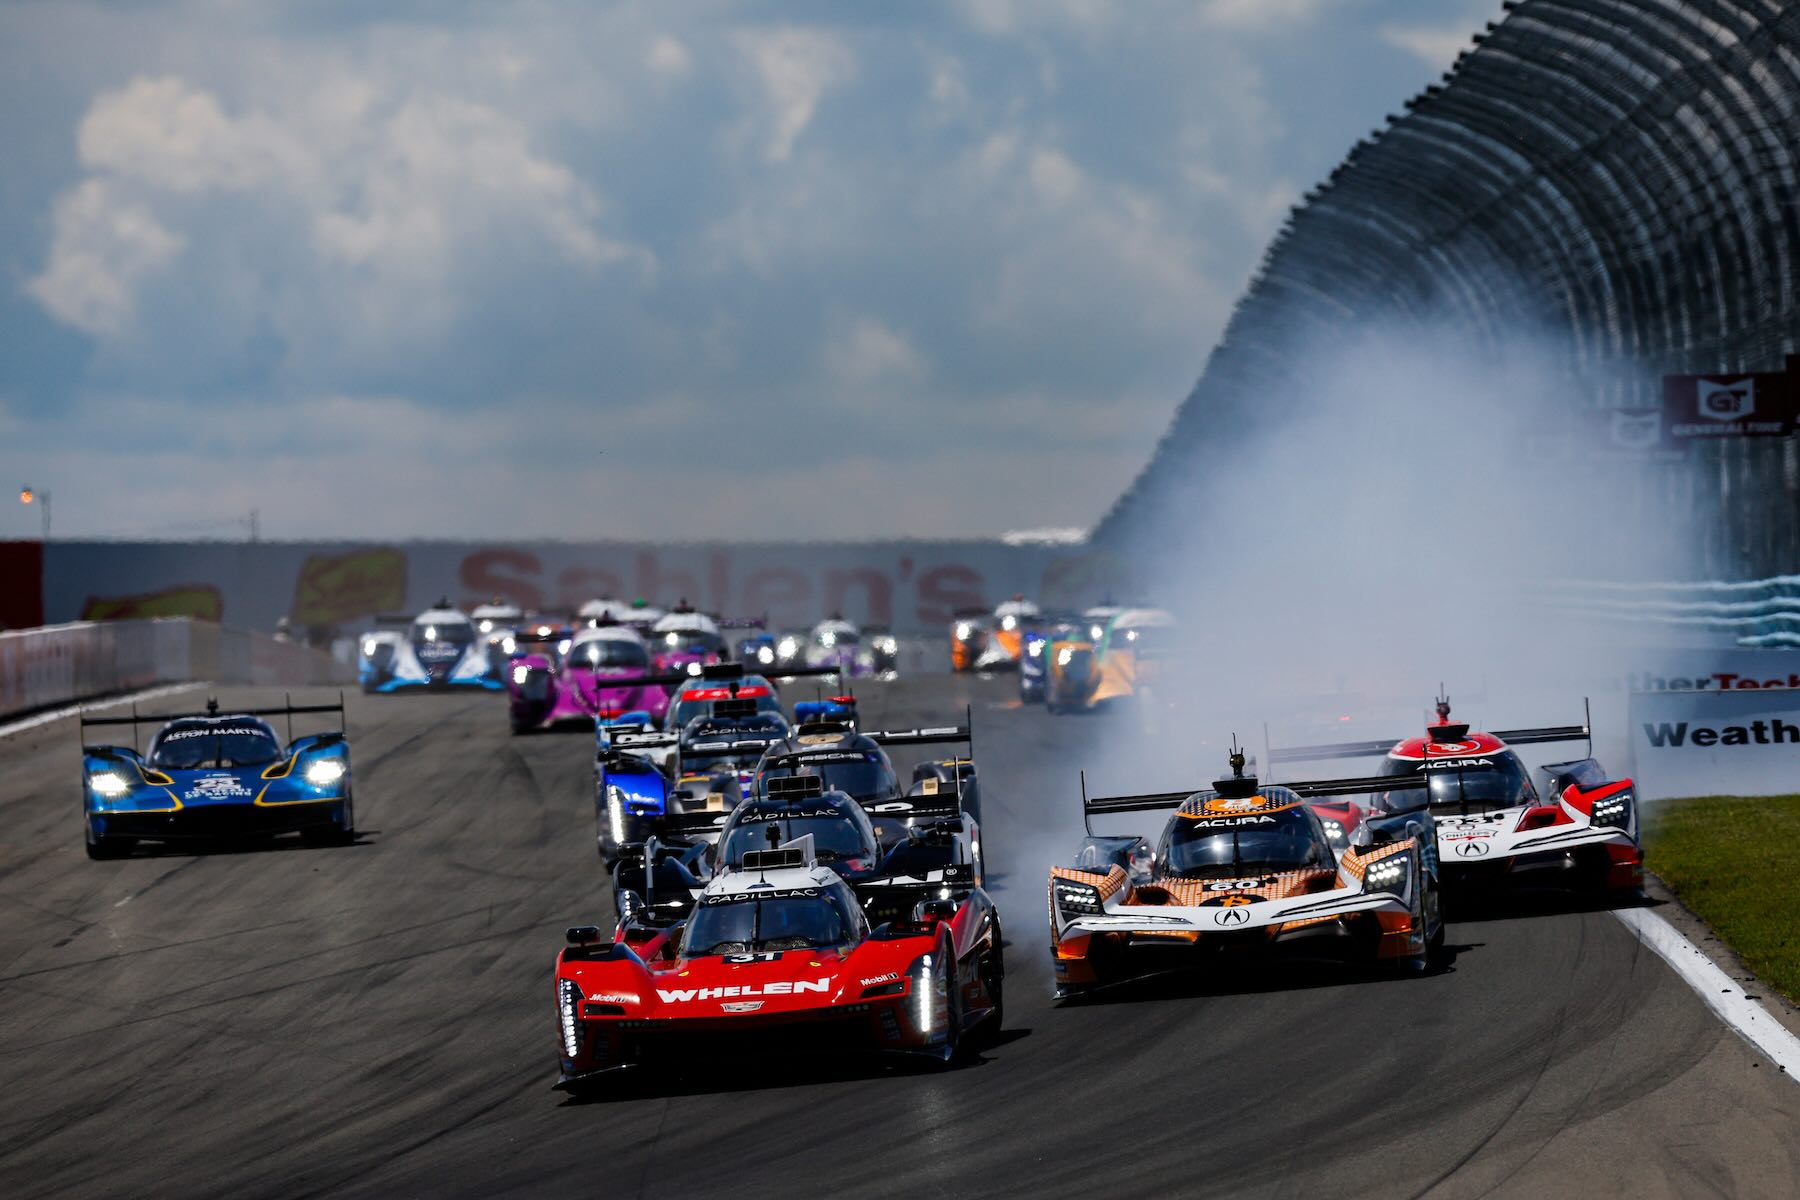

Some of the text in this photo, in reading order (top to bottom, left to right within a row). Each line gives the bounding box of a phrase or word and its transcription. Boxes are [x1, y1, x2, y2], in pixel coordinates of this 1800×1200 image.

[163, 728, 209, 743] ASTON
[1416, 758, 1494, 771] ACURA
[741, 808, 840, 824] CADILLAC
[1194, 815, 1277, 829] ACURA
[1210, 880, 1259, 891] 60
[708, 889, 818, 905] CADILLAC
[730, 951, 776, 963] 31
[656, 977, 831, 1004] WHELEN
